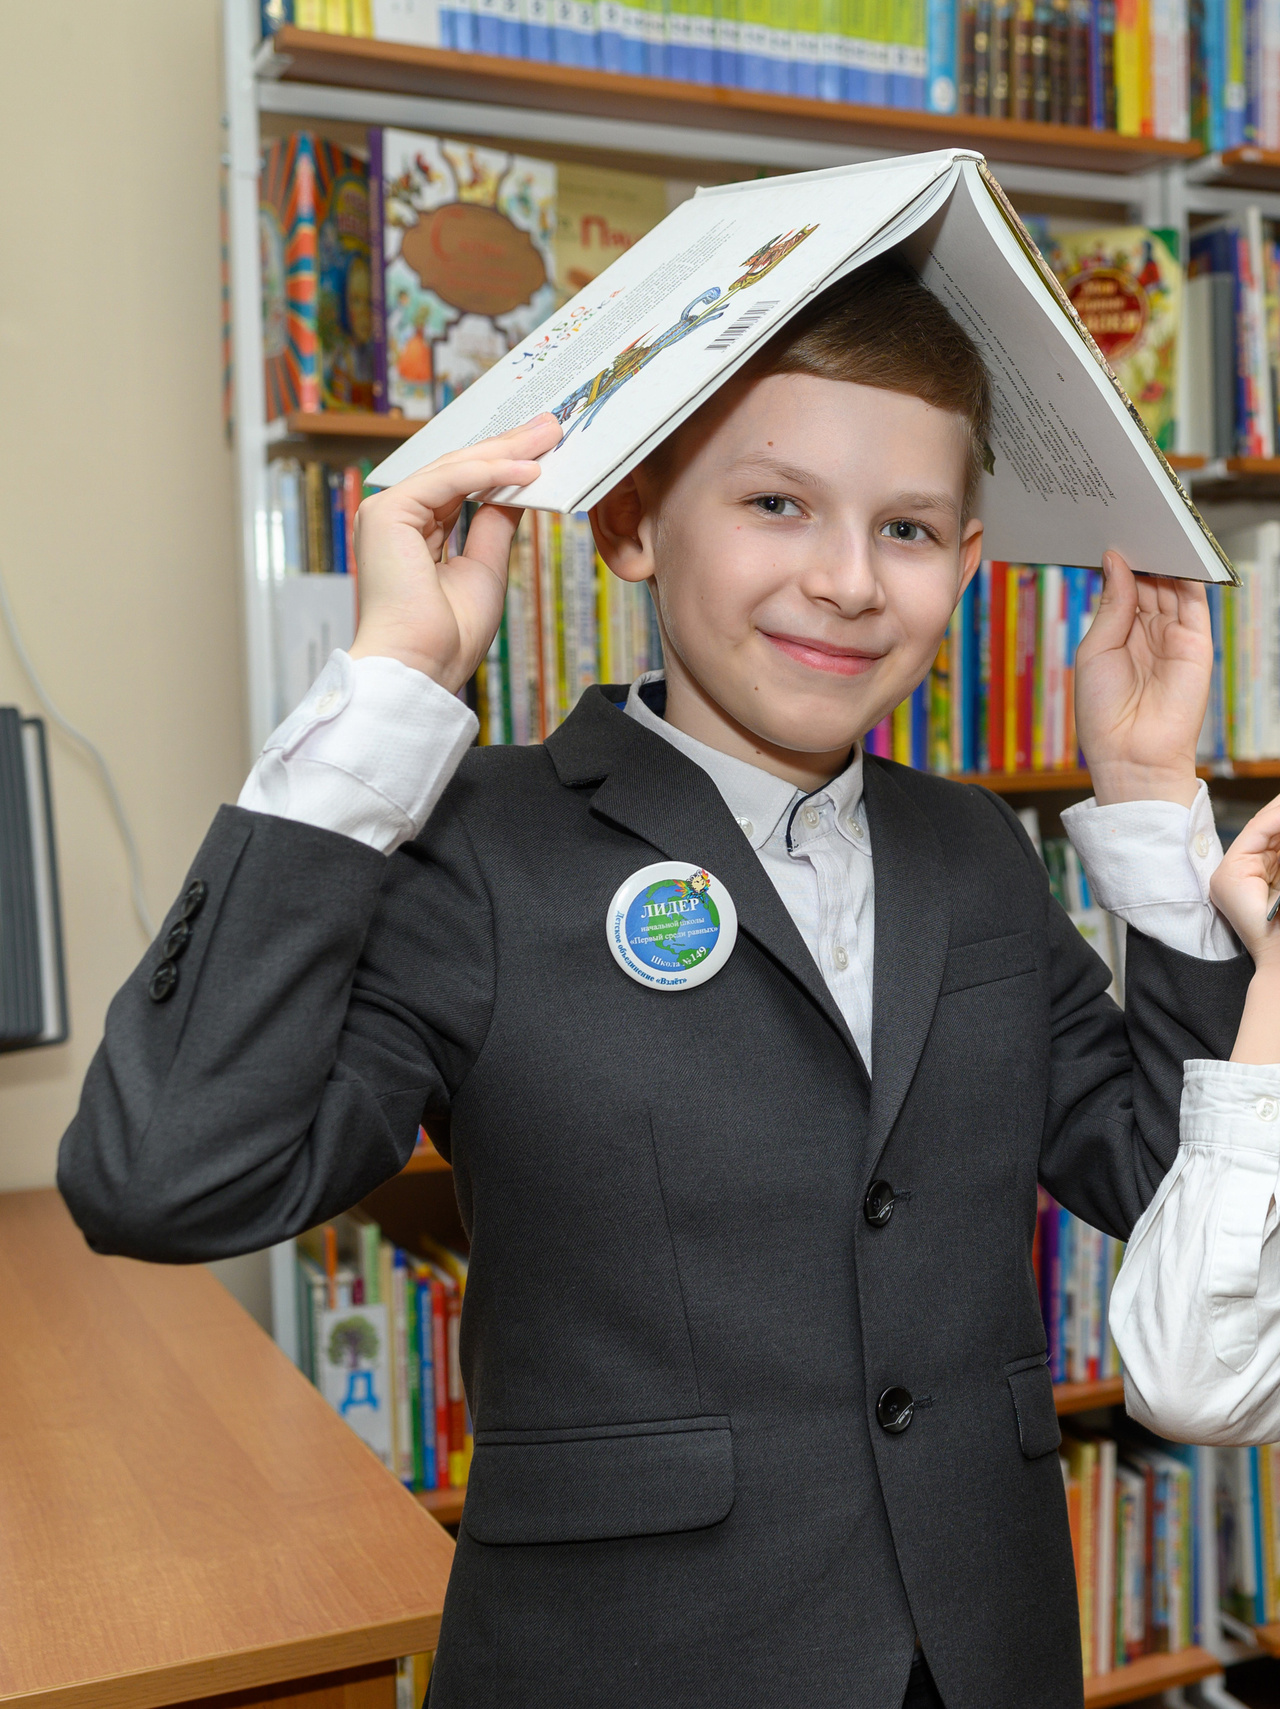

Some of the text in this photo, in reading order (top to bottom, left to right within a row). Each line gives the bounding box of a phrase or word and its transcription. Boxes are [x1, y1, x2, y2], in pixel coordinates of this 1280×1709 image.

[640, 898, 700, 919] ЛИДЕР
[614, 910, 625, 944] Детское
[640, 917, 705, 933] начальной школы
[665, 931, 686, 941] среди
[617, 944, 655, 982] объединение
[651, 946, 707, 968] Школа №149
